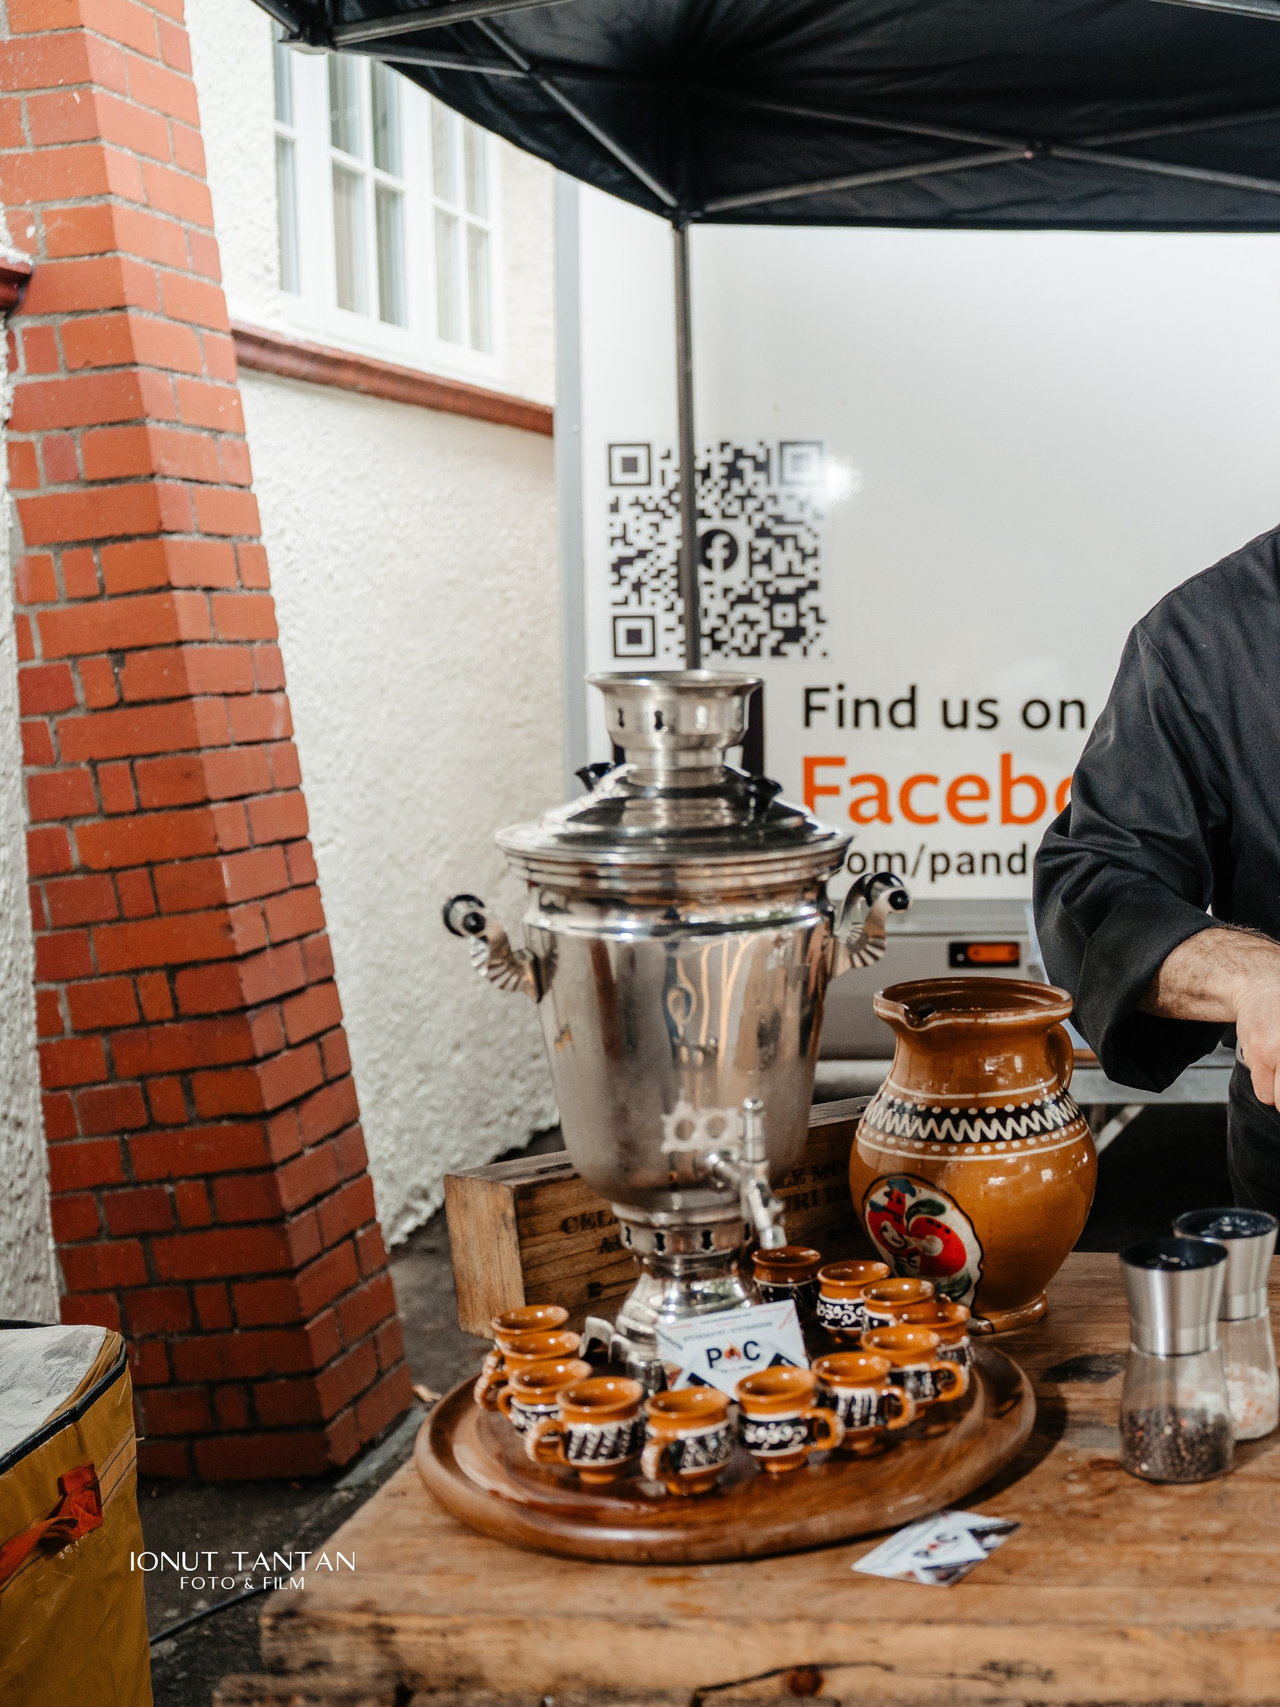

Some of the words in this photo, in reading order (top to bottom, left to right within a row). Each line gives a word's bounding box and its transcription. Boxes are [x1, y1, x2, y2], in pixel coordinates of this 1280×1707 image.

[803, 683, 917, 729] Find
[942, 698, 999, 730] us
[1022, 699, 1087, 730] on
